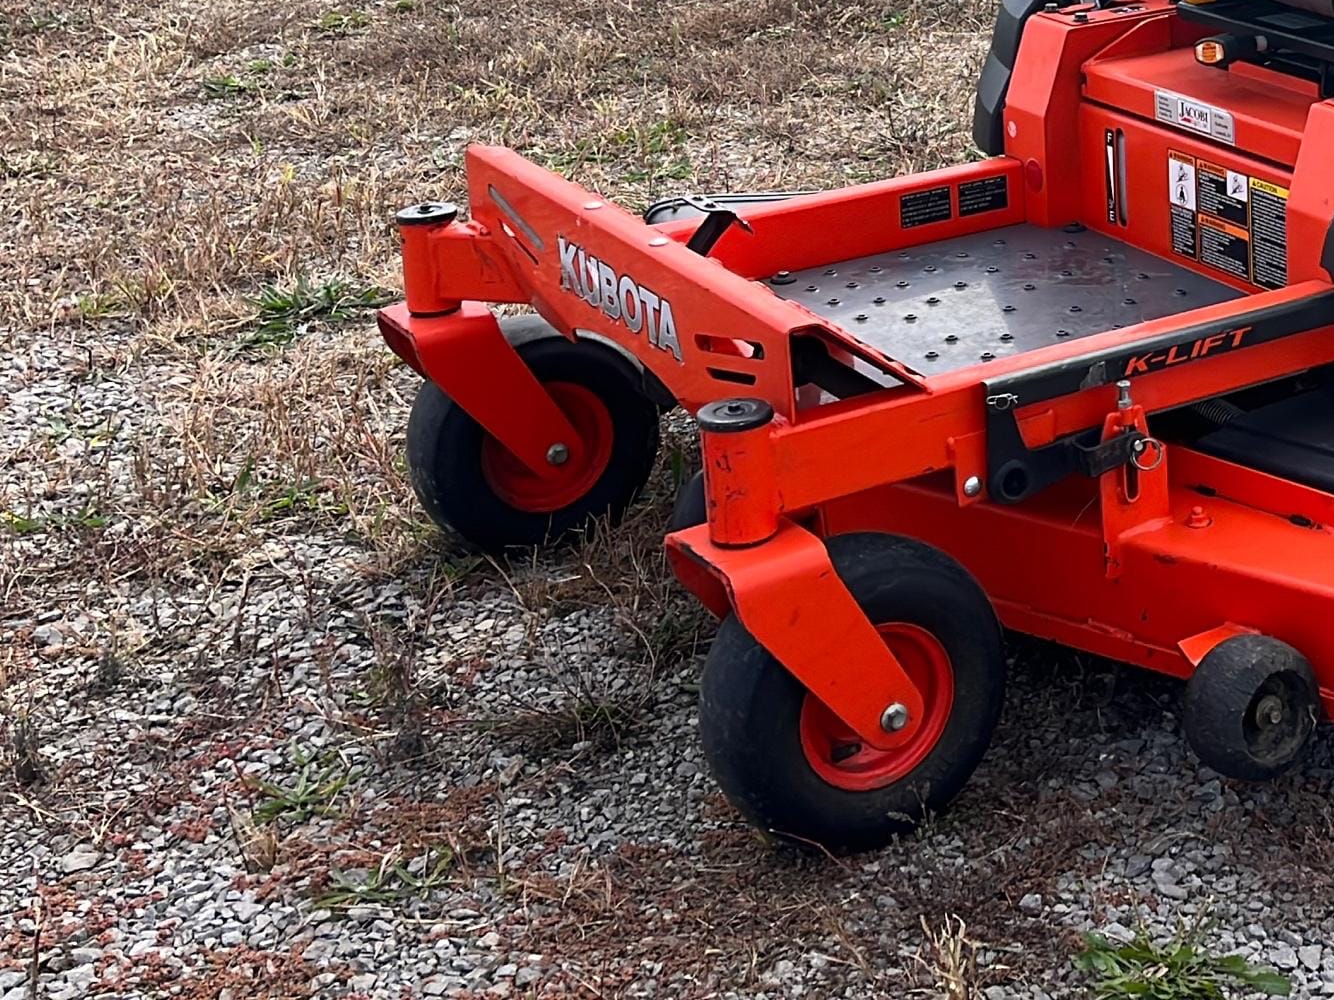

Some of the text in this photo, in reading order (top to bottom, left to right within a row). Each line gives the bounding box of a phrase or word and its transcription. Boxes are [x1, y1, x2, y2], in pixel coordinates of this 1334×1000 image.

[1179, 101, 1208, 123] JACOBI
[1257, 181, 1278, 193] CAUTION
[556, 233, 685, 363] KUBOTA
[1124, 326, 1252, 376] K-LIFT
